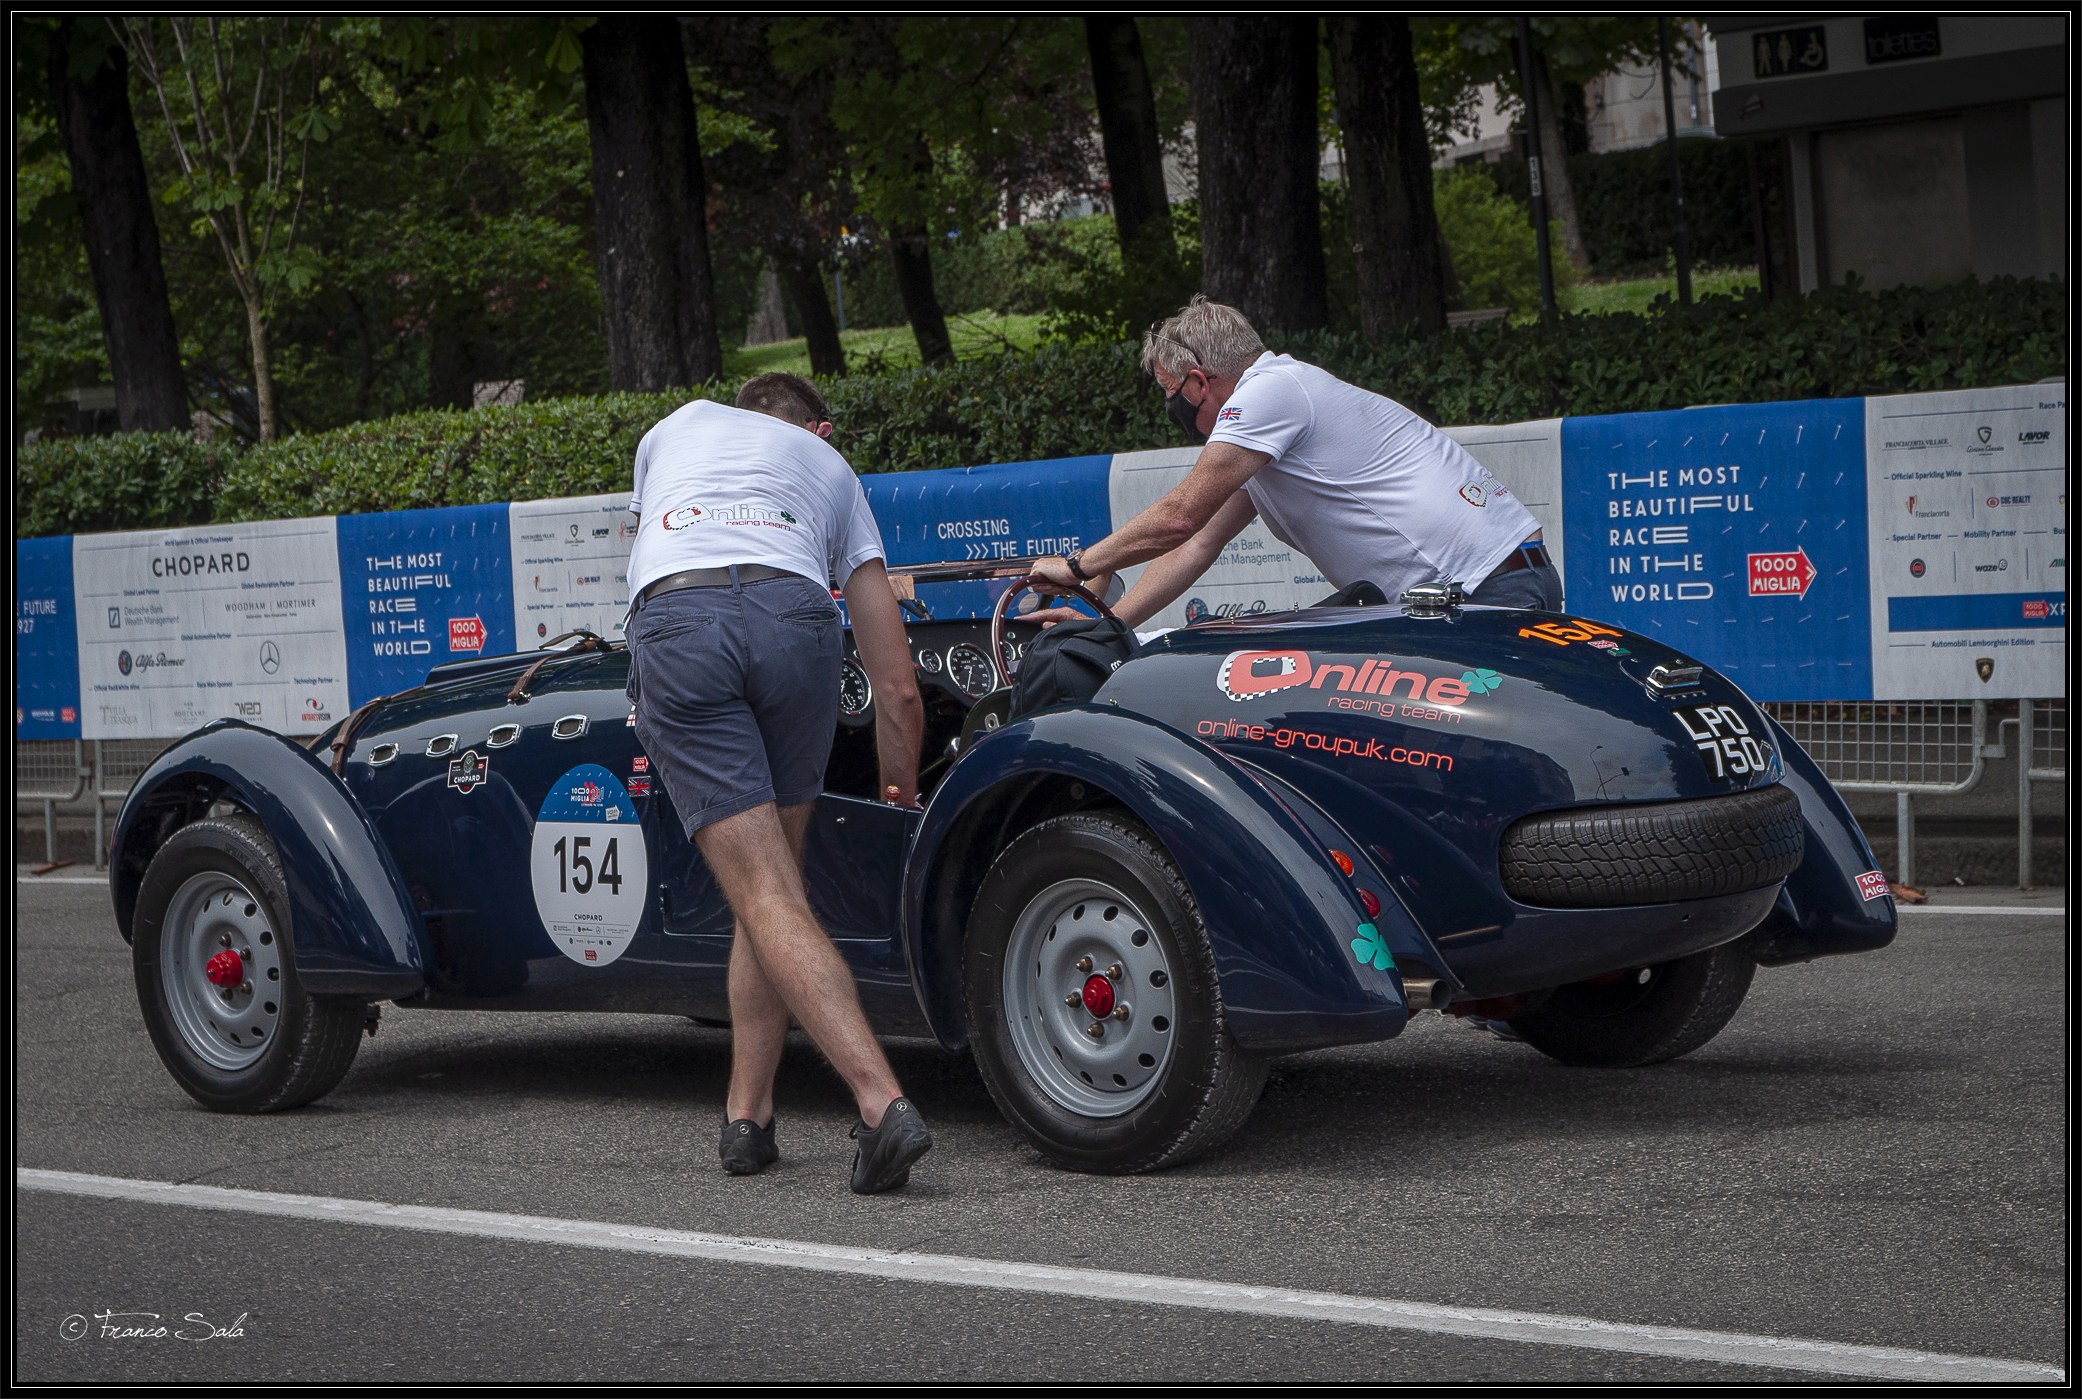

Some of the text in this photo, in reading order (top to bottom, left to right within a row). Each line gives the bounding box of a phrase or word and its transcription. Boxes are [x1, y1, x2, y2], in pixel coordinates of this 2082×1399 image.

[2038, 402, 2056, 410] Race
[2018, 431, 2050, 441] LAVOR
[1608, 466, 1740, 490] THE MOST
[1891, 470, 1962, 481] Official Sparkling Wine
[1608, 494, 1754, 518] BEAUTIFUL
[1915, 510, 1950, 518] Franciacorta
[663, 503, 791, 530] Online
[763, 520, 791, 532] team
[937, 518, 1010, 540] CROSSING
[1609, 526, 1689, 546] RACE
[1892, 532, 1942, 542] Special Partner
[1963, 530, 2017, 539] Mobility Partner
[991, 536, 1080, 558] THE FUTURE
[1240, 538, 1264, 550] Bank
[152, 552, 250, 578] CHOPARD
[366, 552, 442, 571] THE MOST
[1231, 552, 1291, 567] Management
[1610, 554, 1703, 575] IN THE
[1754, 557, 1797, 572] 1000
[1975, 564, 1998, 572] waze
[367, 574, 452, 593] BEAUTIFUL
[1293, 576, 1315, 584] Global
[1753, 576, 1801, 592] MIGLIA
[1611, 582, 1714, 602] WORLD
[23, 600, 57, 615] FUTURE
[124, 605, 164, 616] Deutsche Bank
[224, 599, 316, 612] WOODHAM MORTIMER
[369, 597, 417, 614] RACE
[17, 618, 35, 634] 927
[124, 616, 180, 627] Wealth Management
[371, 618, 426, 635] IN THE
[452, 621, 477, 634] 1000
[1518, 620, 1623, 646] 154
[373, 640, 431, 657] WORLD
[451, 636, 479, 648] MIGLIA
[1931, 638, 2035, 648] Automobili Lamborghini Edition
[135, 652, 185, 673] Alfa Romeo
[1217, 650, 1474, 706] Online
[1327, 695, 1461, 724] racing team
[1197, 718, 1454, 771] online-groupuk.com
[1697, 737, 1765, 778] 750
[453, 774, 480, 784] CHOPARD
[553, 835, 622, 896] 154
[574, 913, 603, 921] CHOPARD
